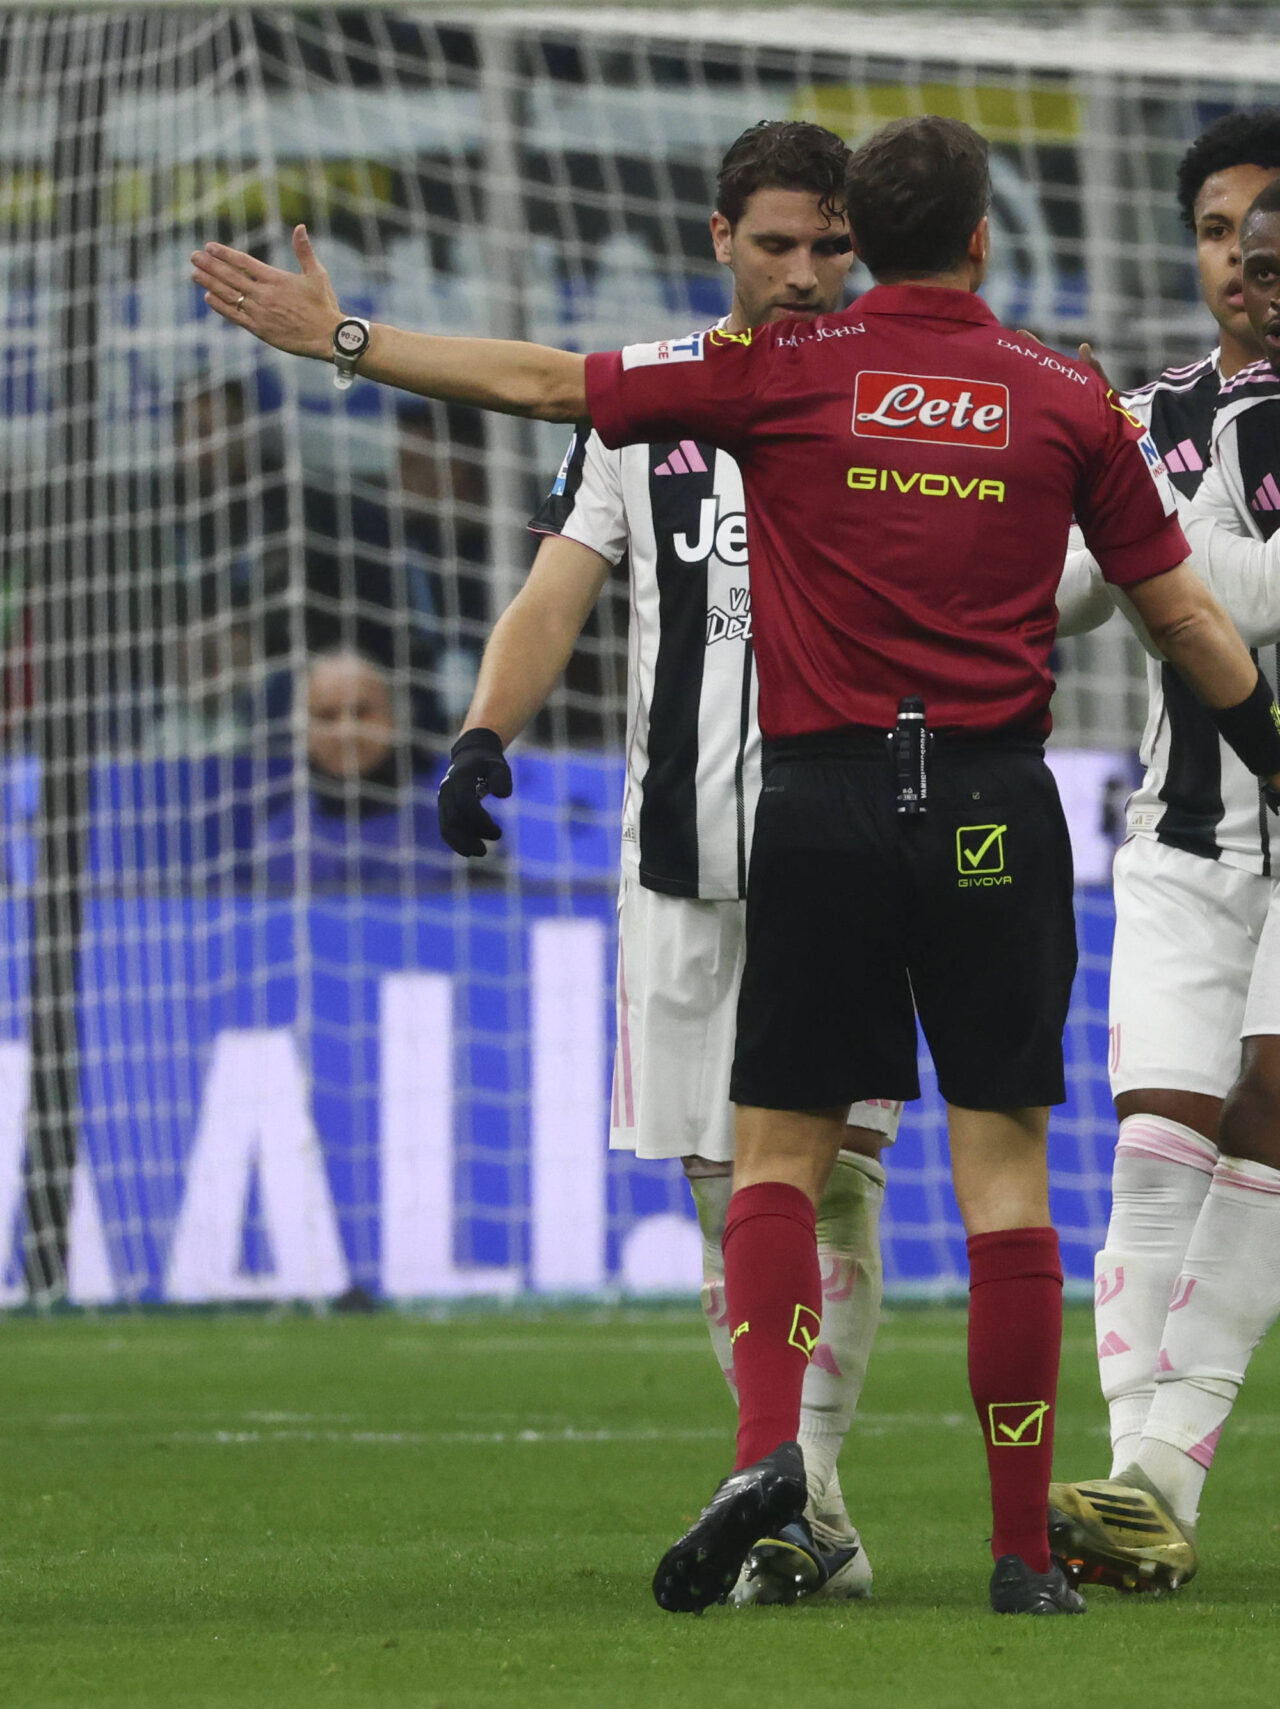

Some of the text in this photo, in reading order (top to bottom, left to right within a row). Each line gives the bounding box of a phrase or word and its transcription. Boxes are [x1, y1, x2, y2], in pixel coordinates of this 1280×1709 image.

[673, 333, 700, 356] T
[816, 322, 866, 341] JOHN
[997, 338, 1088, 385] DAN JOHN
[857, 383, 1004, 433] Lete
[847, 467, 1005, 502] GIVOVA
[958, 876, 1012, 888] GIVOVA
